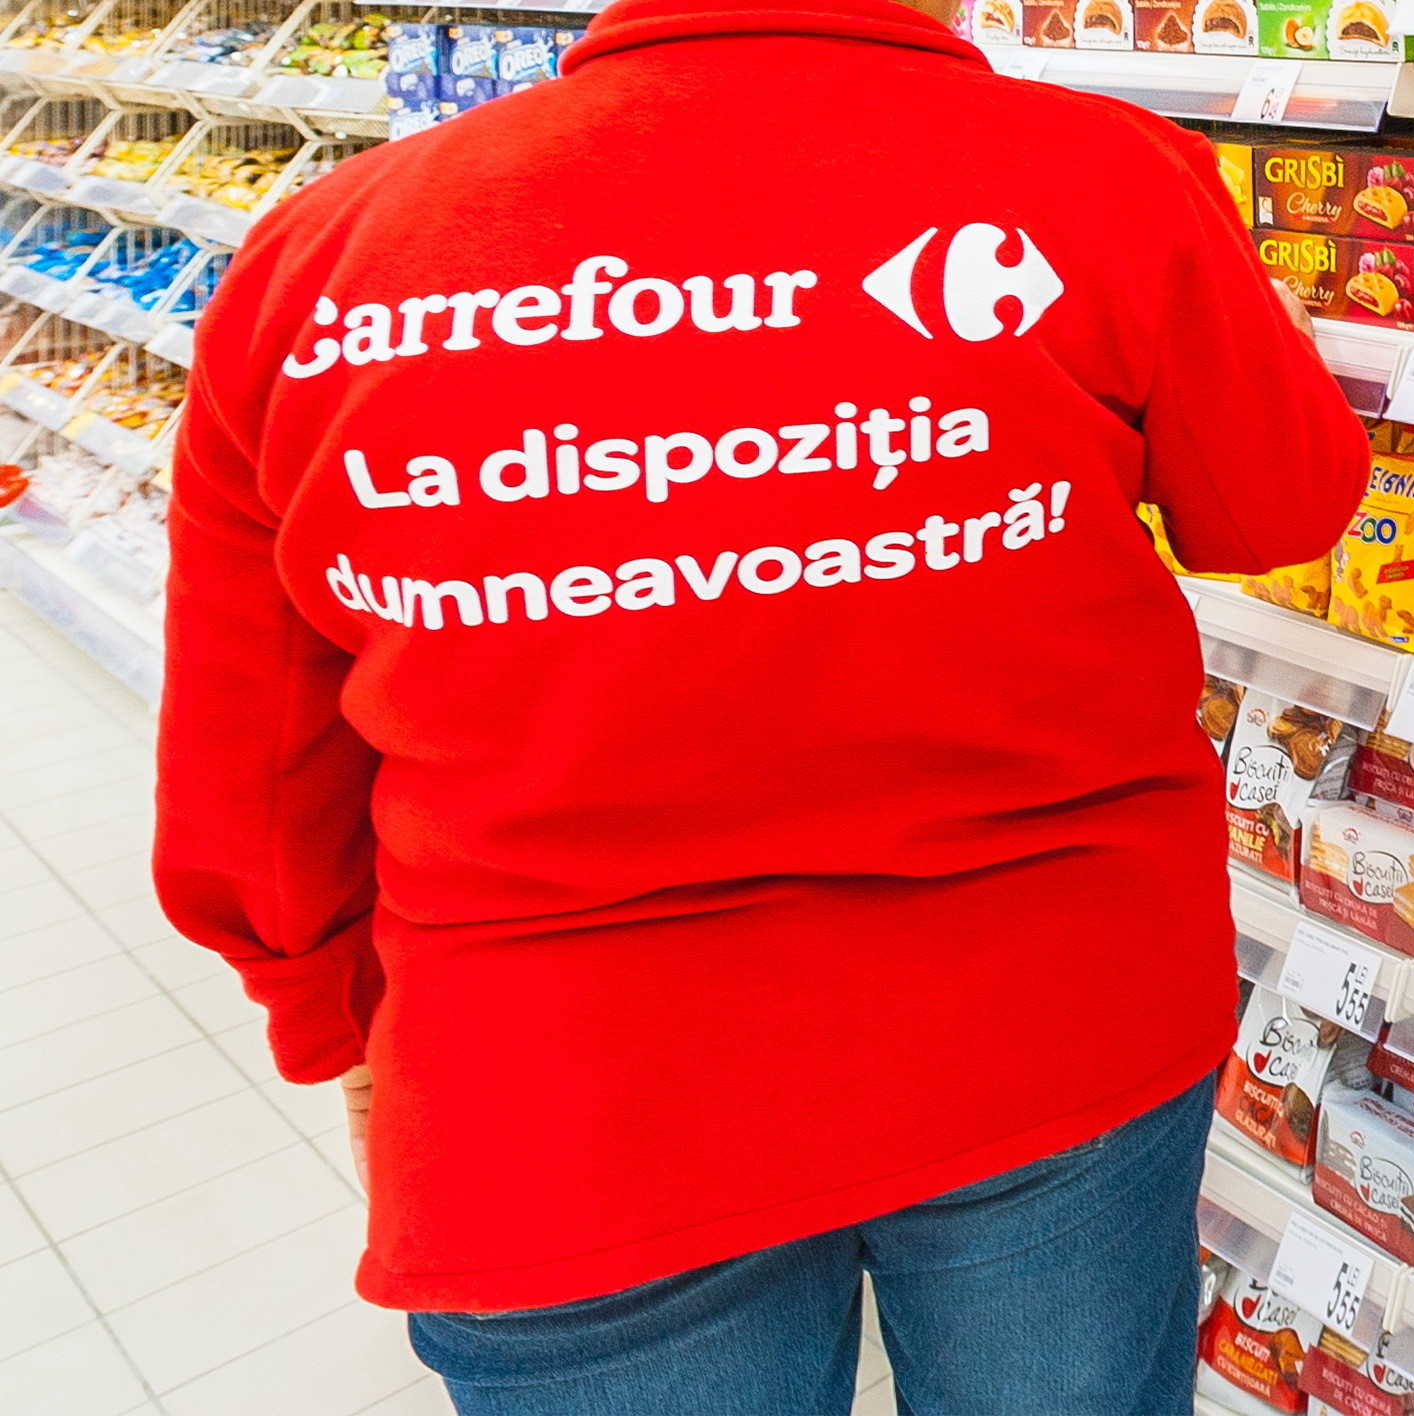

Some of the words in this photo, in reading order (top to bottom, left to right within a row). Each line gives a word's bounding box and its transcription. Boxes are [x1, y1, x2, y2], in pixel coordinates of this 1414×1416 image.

[503, 42, 544, 82] OREO
[1286, 193, 1343, 221] Cherry
[282, 253, 819, 380] Carrefour
[343, 447, 460, 511] La
[326, 479, 1073, 631] dumneavoastră!
[1348, 511, 1397, 545] ZOO
[1339, 962, 1357, 1016] 5
